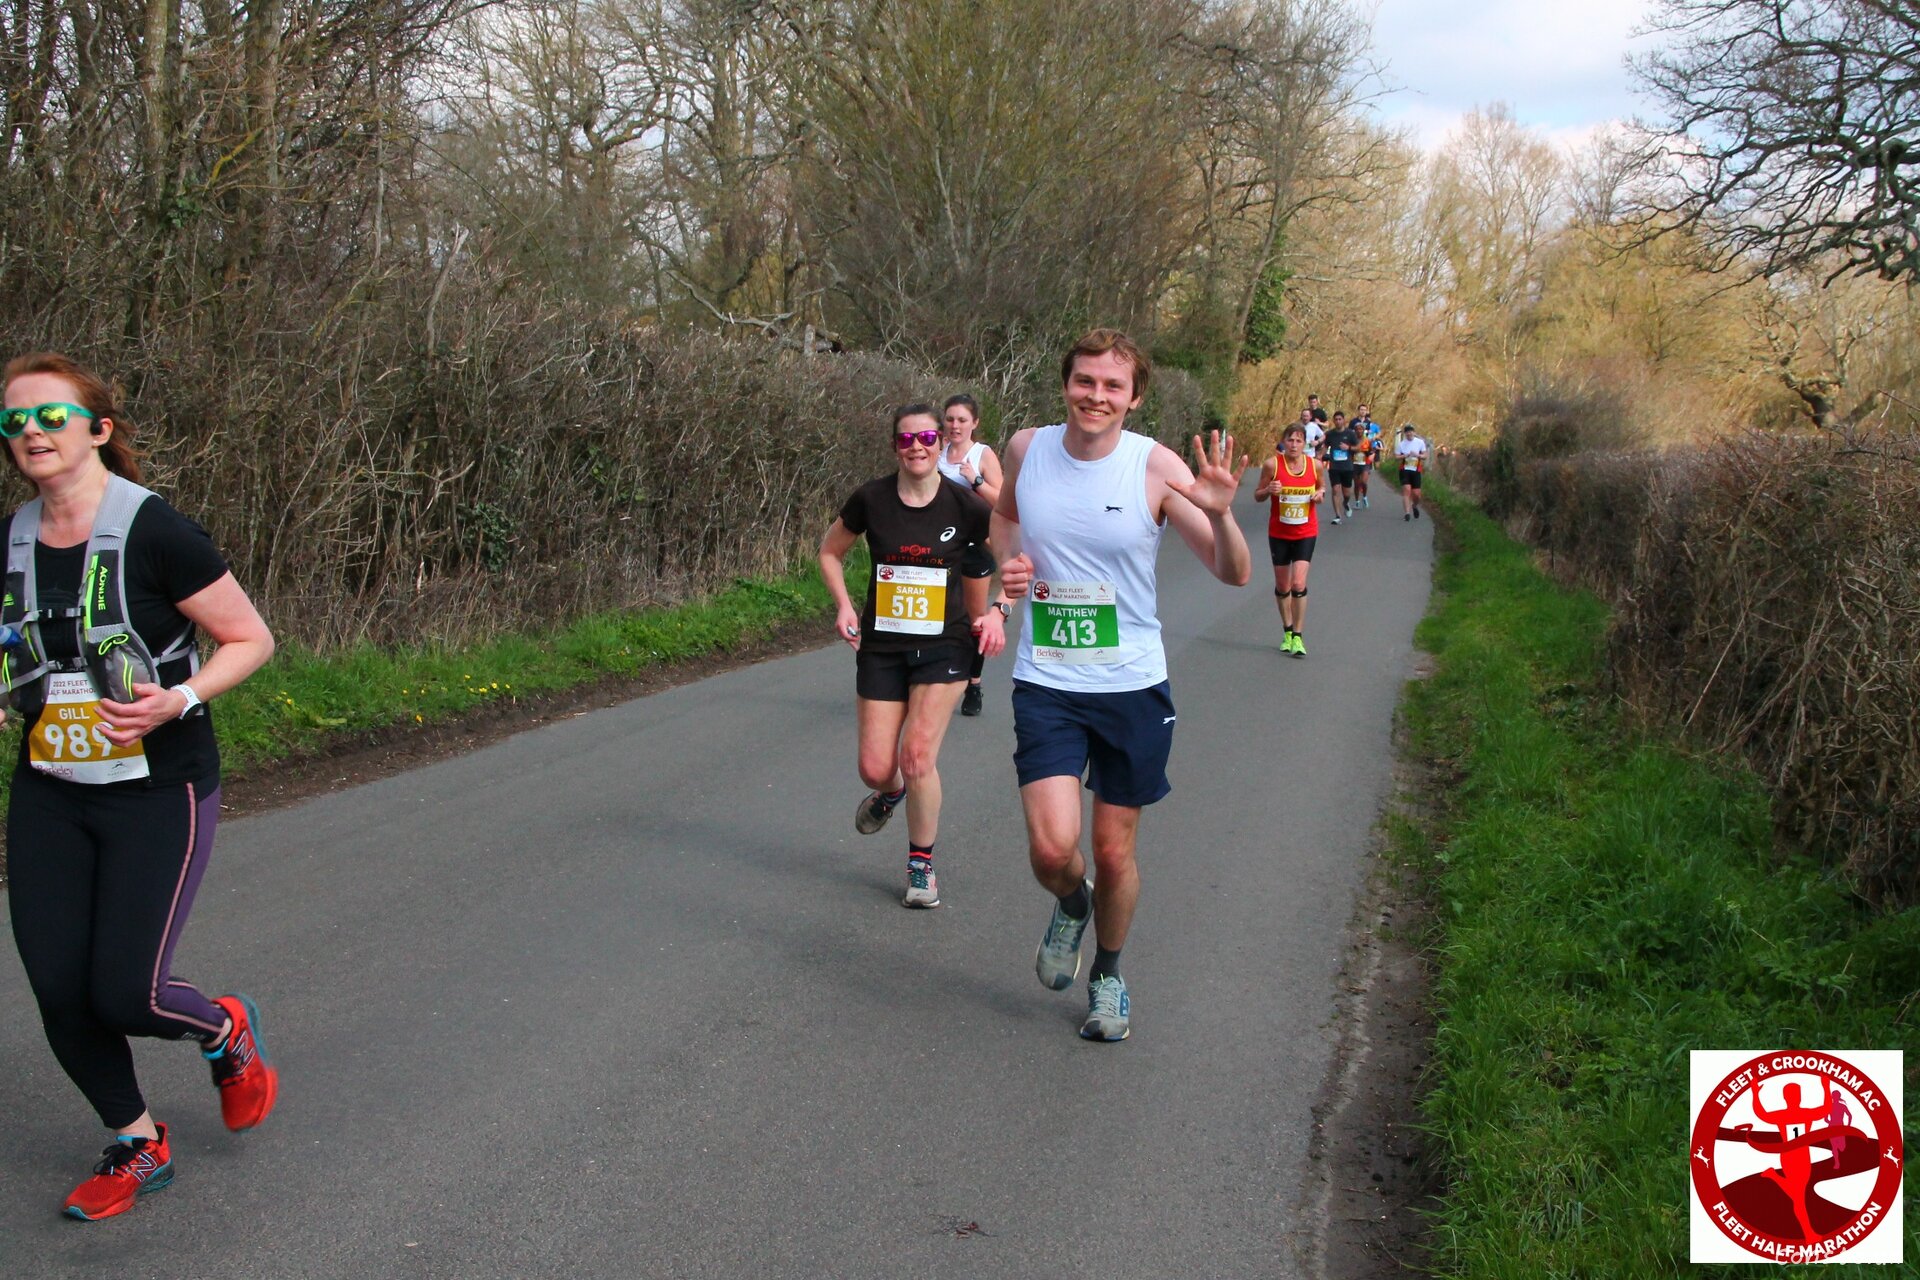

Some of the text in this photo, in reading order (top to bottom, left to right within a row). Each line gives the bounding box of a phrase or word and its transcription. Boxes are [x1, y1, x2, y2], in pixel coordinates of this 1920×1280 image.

[899, 545, 931, 556] SPORT
[896, 586, 926, 595] SARAH
[891, 595, 929, 619] 513
[1047, 606, 1098, 618] MATTHEW
[1051, 619, 1097, 646] 413
[1036, 648, 1064, 660] Berkeley
[58, 707, 90, 720] GILL
[44, 721, 114, 759] 989
